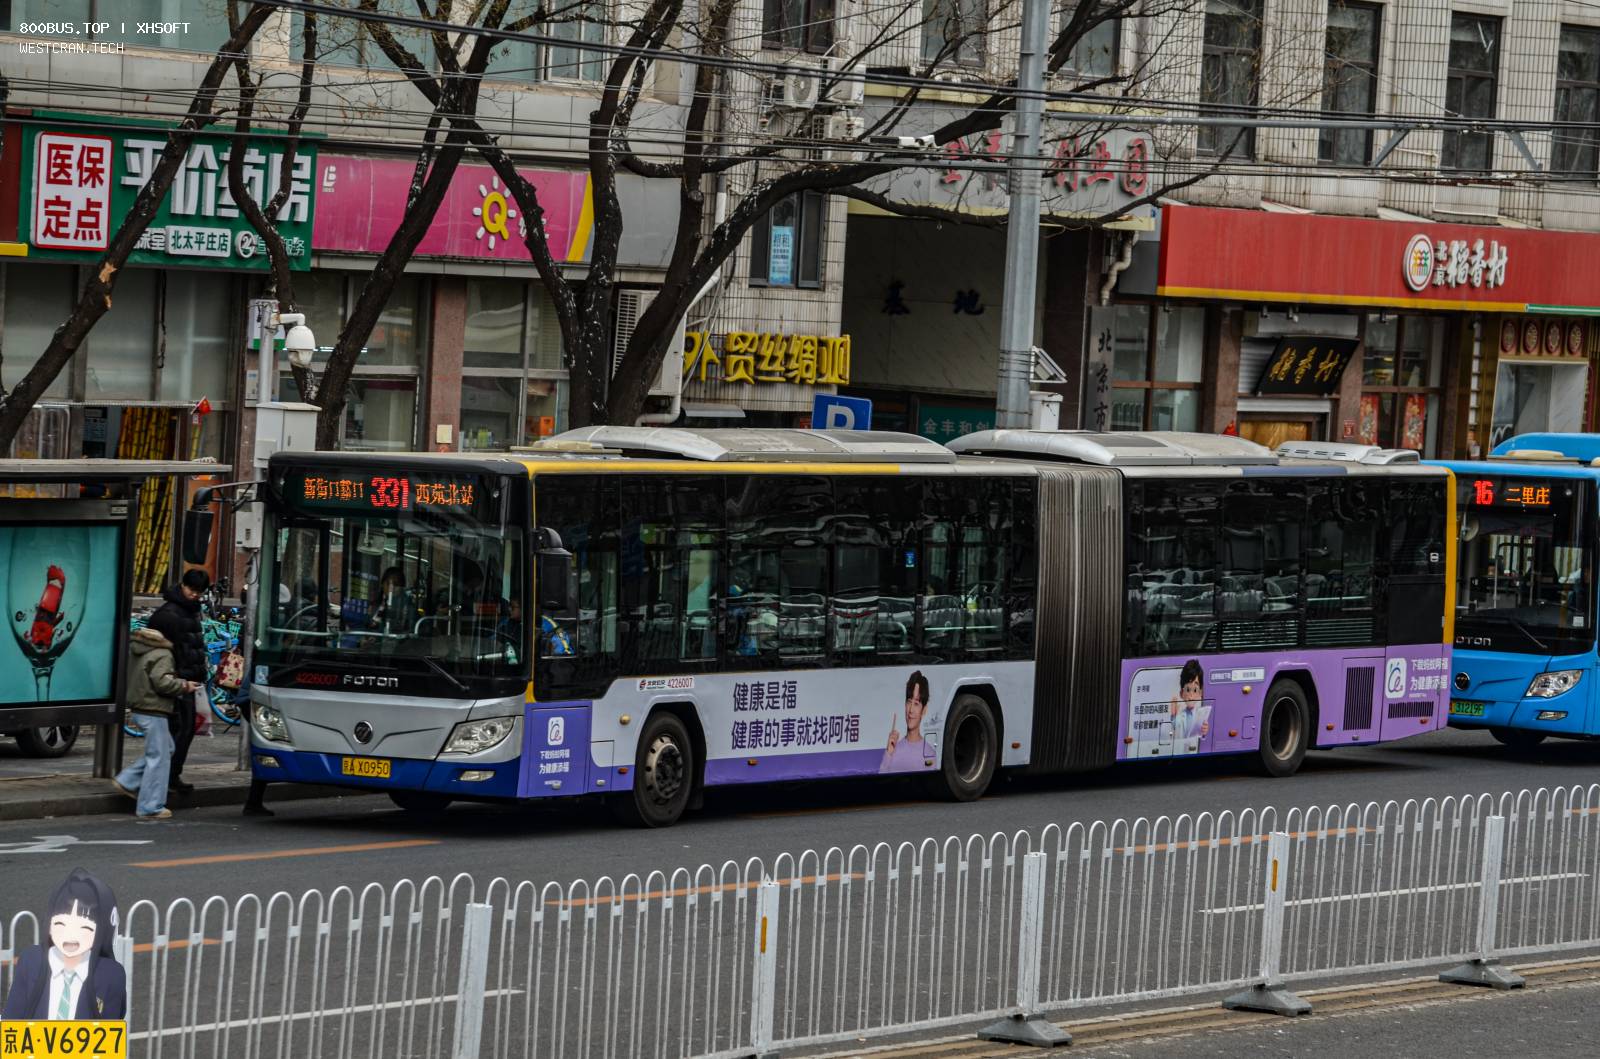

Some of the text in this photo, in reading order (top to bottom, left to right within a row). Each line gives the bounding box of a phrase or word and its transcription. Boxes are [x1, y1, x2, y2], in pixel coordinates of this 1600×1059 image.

[46, 144, 105, 189] 医保
[43, 195, 103, 242] 定点
[171, 230, 229, 252] 北太平庄店
[1447, 239, 1508, 288] 稻香村
[370, 476, 410, 509] 331
[415, 483, 474, 506] 西苑北站
[1473, 480, 1551, 505] 16 二里庄
[343, 674, 399, 688] FOTON
[667, 677, 694, 689] 4226007
[732, 680, 798, 713] 健康是福
[731, 714, 861, 750] 健康的事就找阿福
